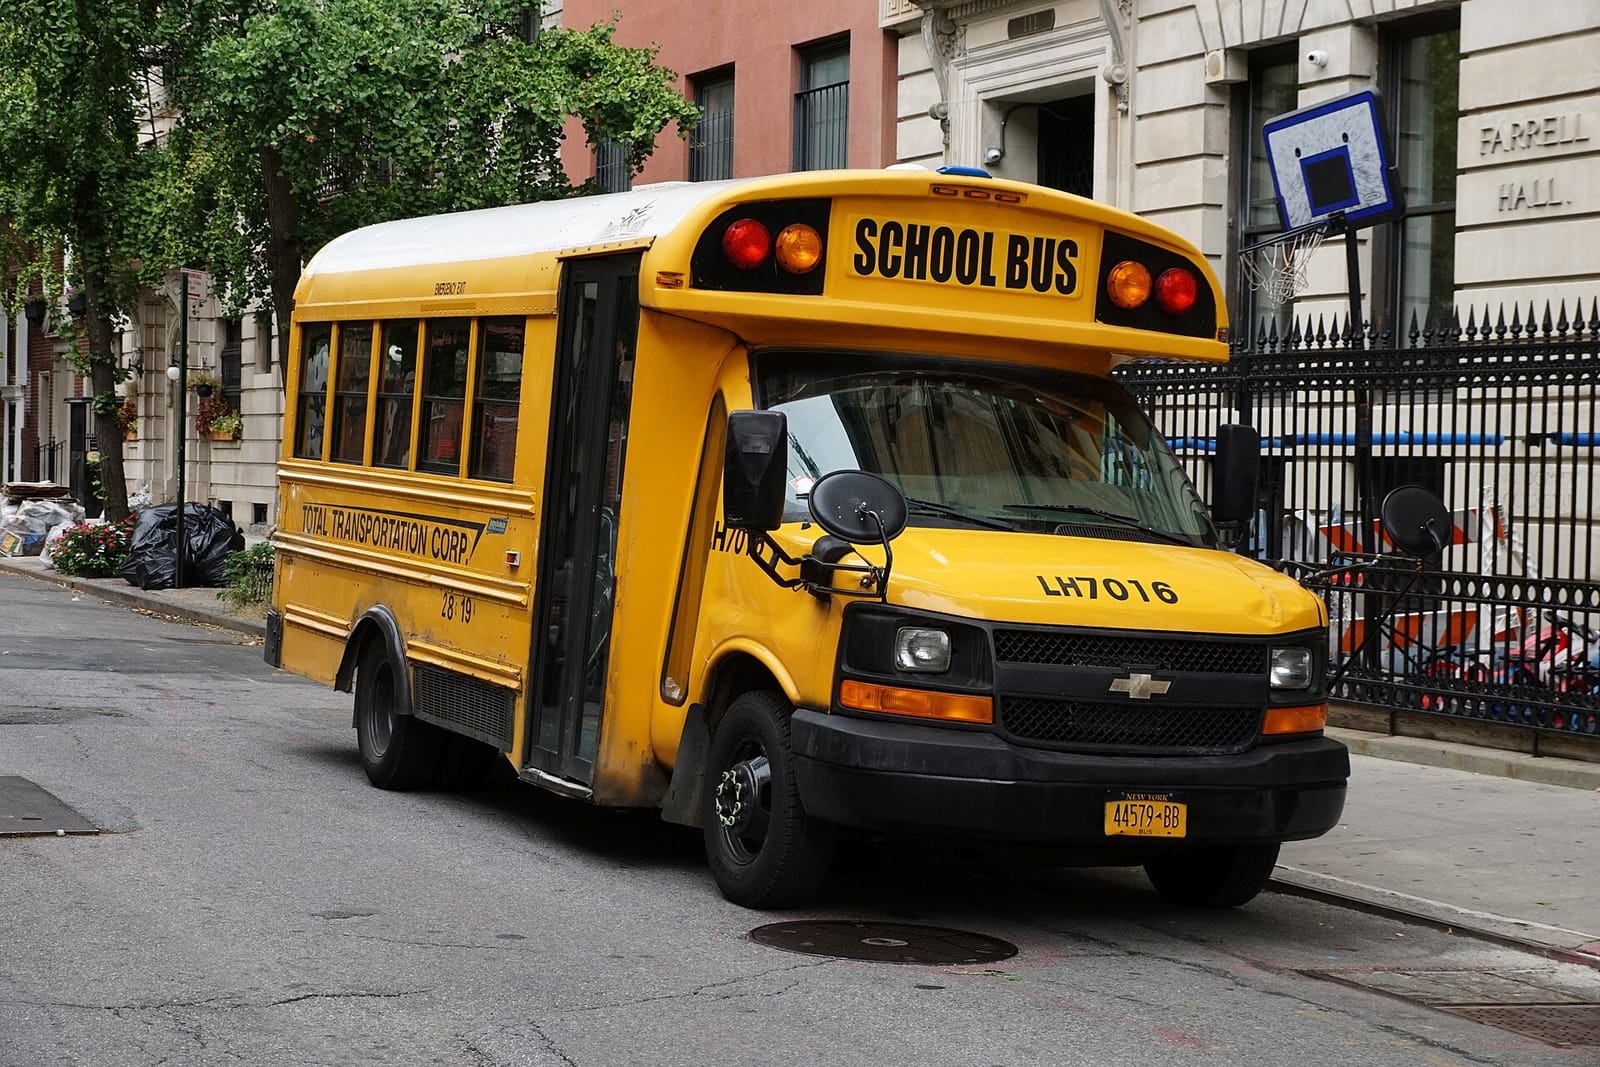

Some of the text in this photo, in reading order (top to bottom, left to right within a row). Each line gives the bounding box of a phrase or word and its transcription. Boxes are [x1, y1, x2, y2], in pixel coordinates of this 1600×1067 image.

[1480, 113, 1590, 156] FARRELL
[853, 218, 1079, 295] SCHOOL BUS
[302, 505, 469, 566] TOTAL TRANSPORTATION CORP.
[1036, 575, 1179, 604] LH7016
